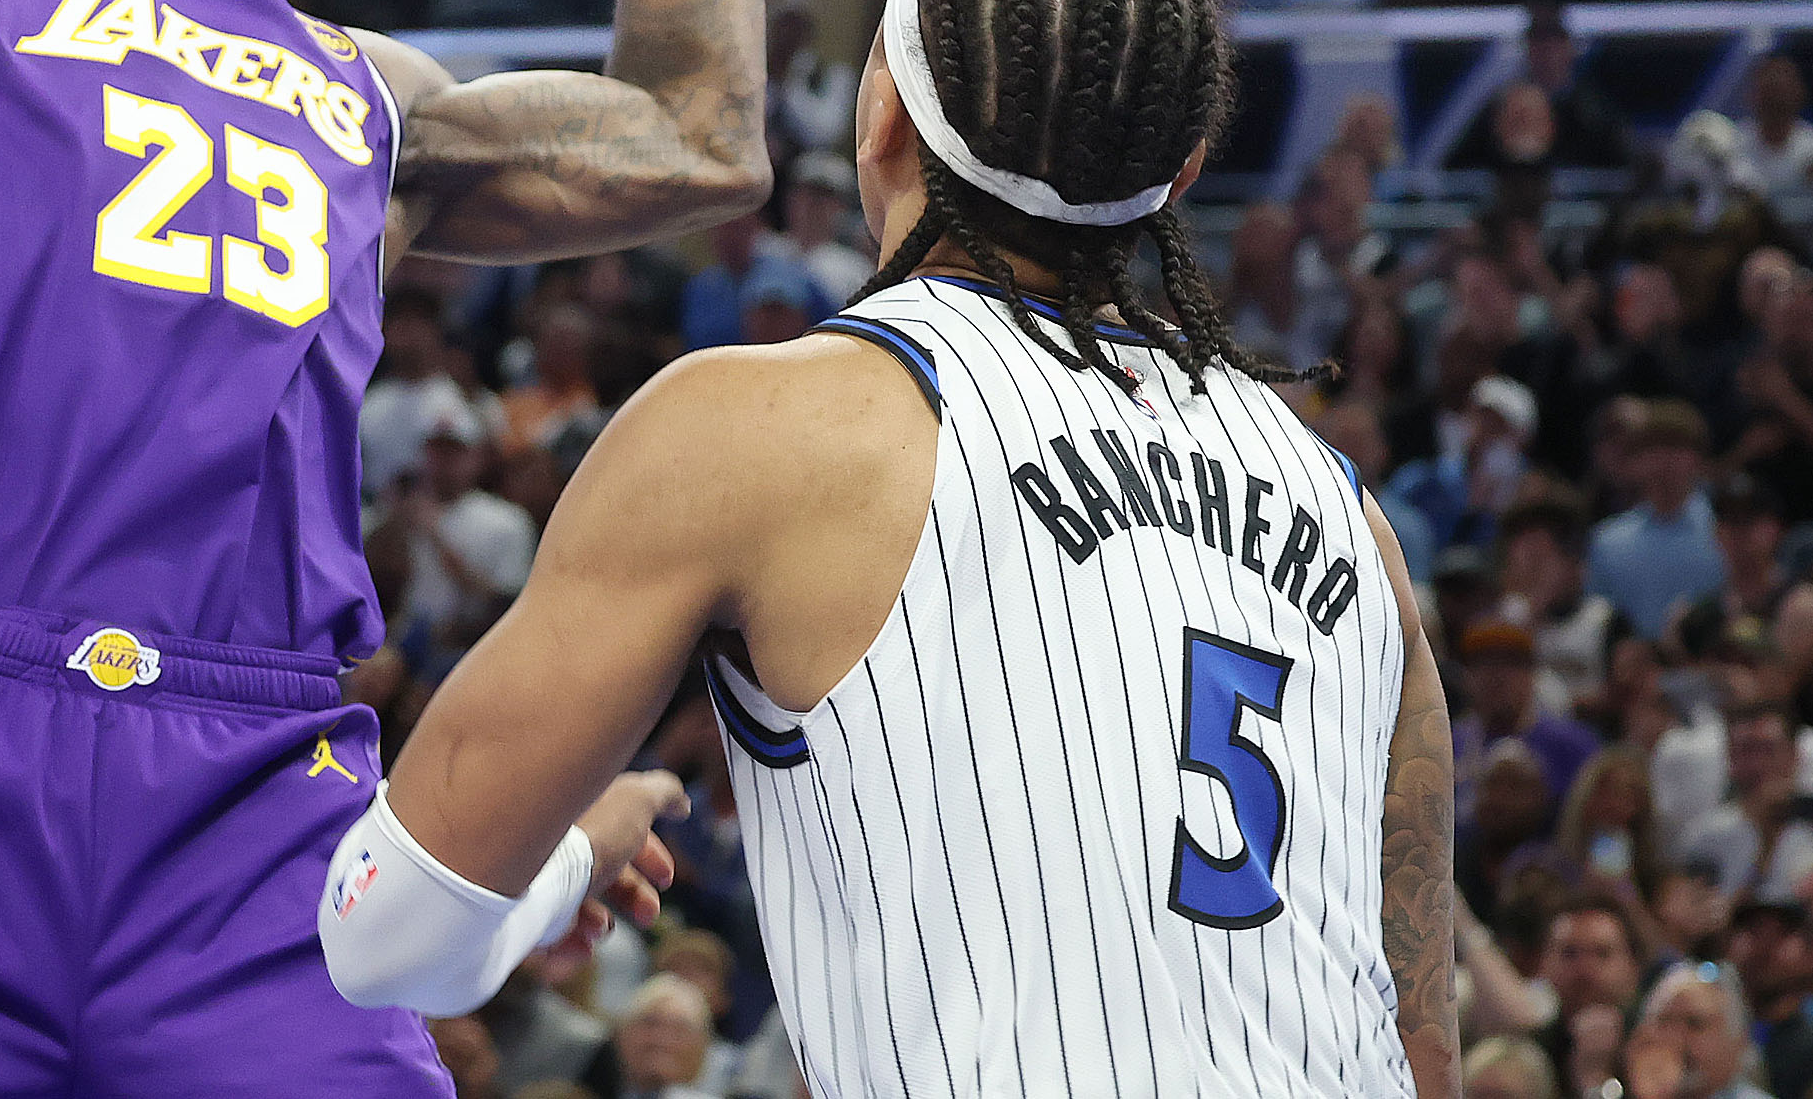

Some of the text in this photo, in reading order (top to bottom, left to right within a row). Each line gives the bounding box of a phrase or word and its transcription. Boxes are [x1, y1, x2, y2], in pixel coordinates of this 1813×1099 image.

[93, 83, 329, 328] 23
[1011, 428, 1358, 636] BANCHERO
[66, 635, 161, 686] LAKERS
[1168, 626, 1294, 930] 5
